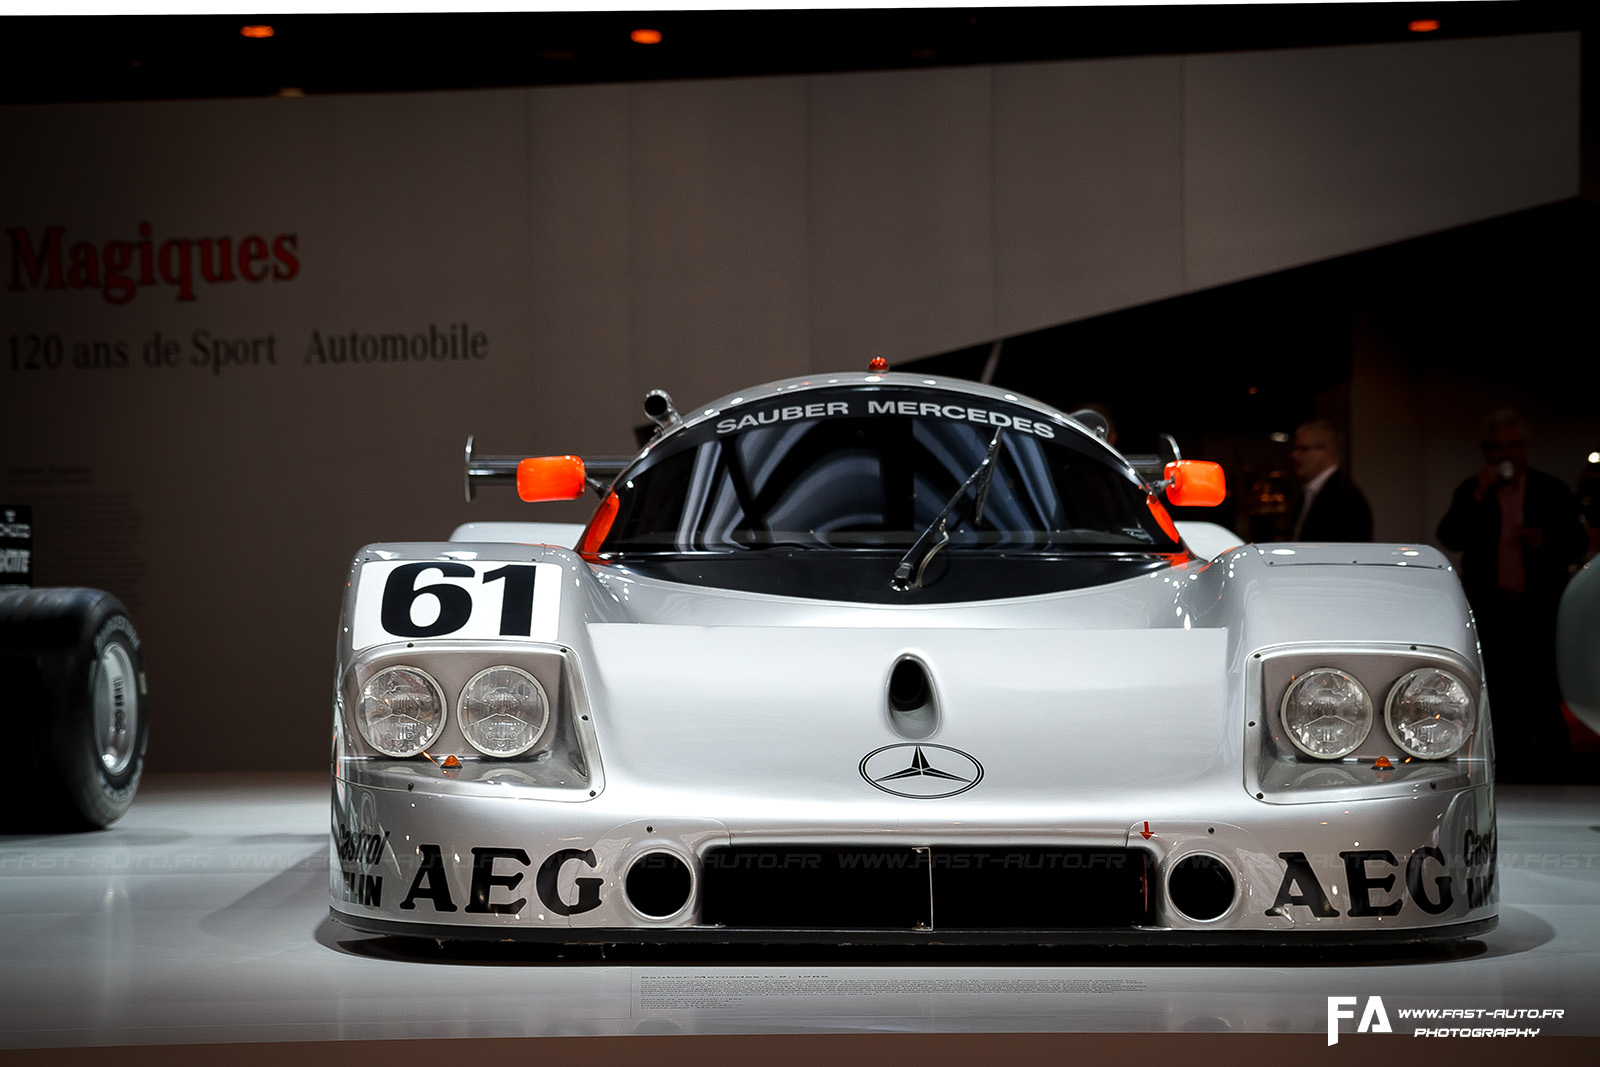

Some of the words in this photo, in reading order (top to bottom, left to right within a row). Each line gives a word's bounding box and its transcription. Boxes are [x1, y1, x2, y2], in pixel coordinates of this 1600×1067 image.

[7, 221, 299, 305] Magiques
[9, 332, 62, 370] 120
[73, 340, 129, 369] ans
[142, 329, 181, 367] de
[191, 328, 277, 375] Sport
[305, 323, 489, 365] Automobile
[716, 402, 849, 434] SAUBER
[868, 401, 1055, 438] MERCEDES
[381, 562, 537, 638] 61
[399, 844, 605, 917] AEG
[1264, 846, 1455, 918] AEG
